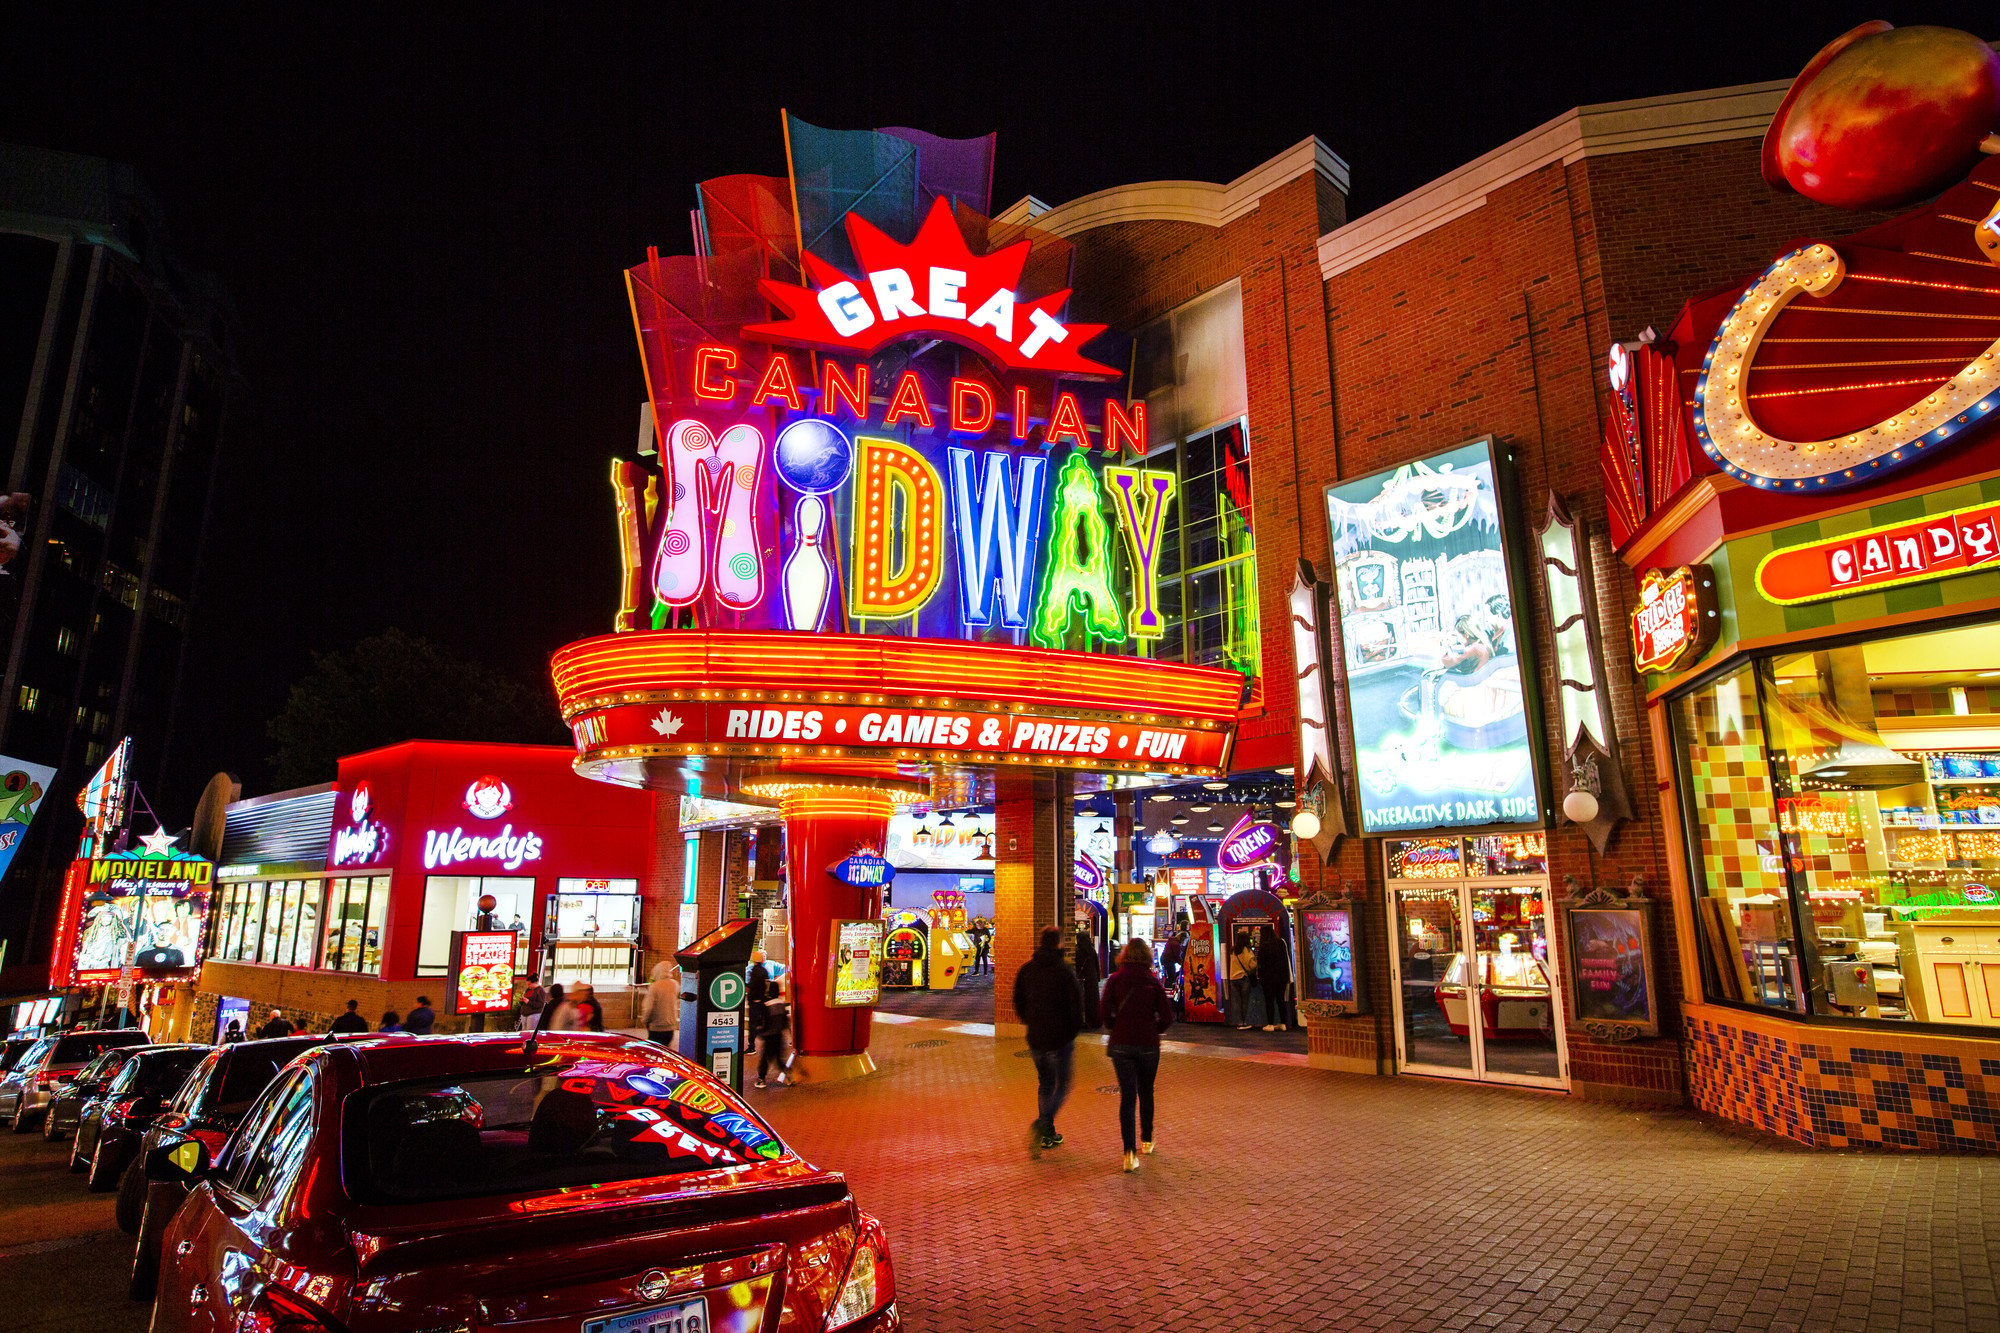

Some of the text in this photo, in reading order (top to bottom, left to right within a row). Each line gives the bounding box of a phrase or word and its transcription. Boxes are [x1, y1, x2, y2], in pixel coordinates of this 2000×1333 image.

[817, 266, 1069, 359] GREAT
[693, 346, 1148, 456] CANADIAN
[1831, 521, 1993, 583] CANDY
[725, 708, 1187, 760] RIDES GAMES & PRIZES FUN
[1363, 795, 1537, 827] INTERACTIVE DARK RIDE
[334, 819, 378, 866] Wendy's
[424, 823, 543, 870] Wendy's
[858, 847, 879, 857] GREAT
[1226, 826, 1271, 863] TOKENS
[849, 857, 885, 866] CANADIAN
[1401, 849, 1451, 869] Open
[89, 861, 214, 886] MOVIELAND
[585, 880, 610, 891] OPEN
[465, 950, 511, 960] BECAUSE
[719, 978, 737, 1003] P
[712, 1017, 734, 1026] 4543
[808, 1252, 831, 1268] SV
[618, 1310, 674, 1329] Connecticut
